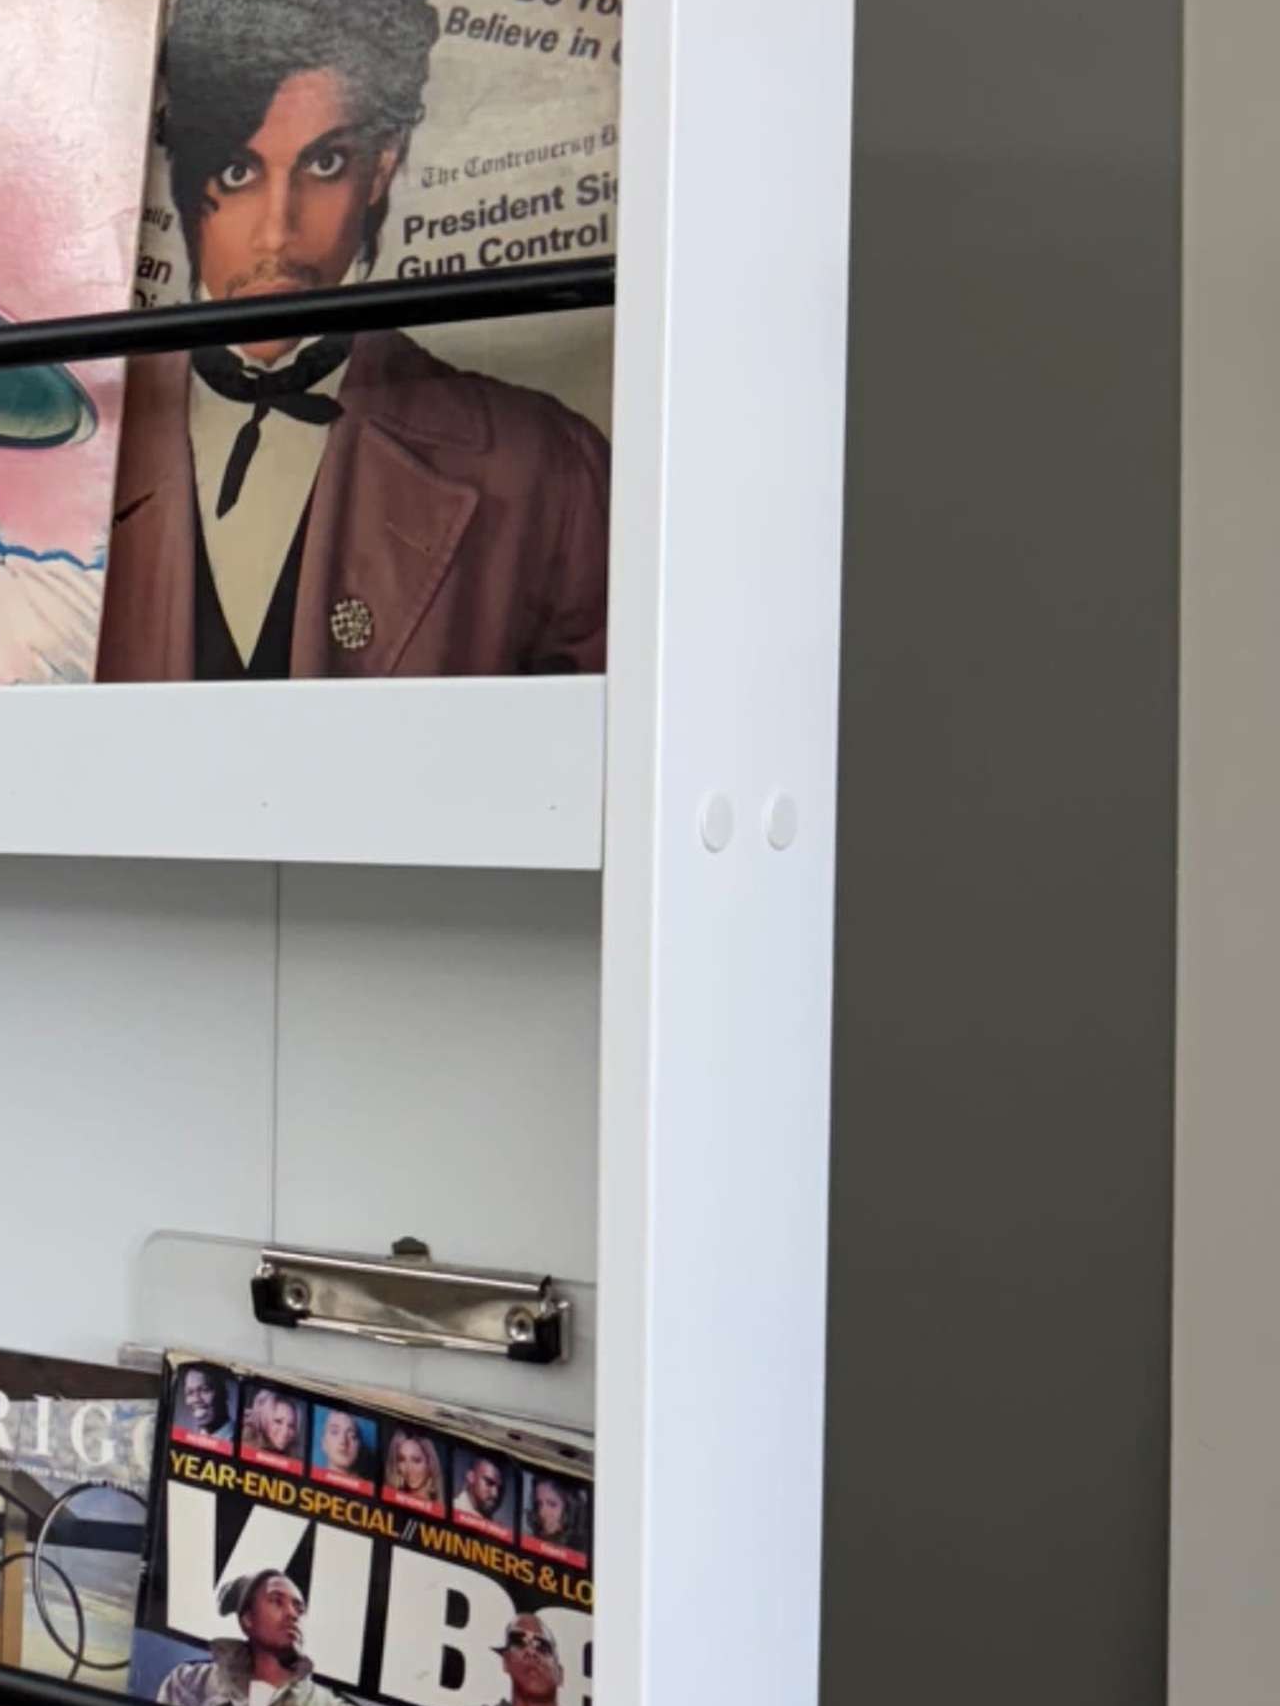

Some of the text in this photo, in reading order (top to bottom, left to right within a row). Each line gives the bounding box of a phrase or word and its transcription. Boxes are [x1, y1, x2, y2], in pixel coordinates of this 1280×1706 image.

[445, 6, 559, 52] Believe
[569, 27, 601, 58] in
[421, 165, 459, 188] The
[464, 133, 595, 179] Controversy
[403, 185, 565, 245] President
[397, 213, 608, 279] Gun Control
[169, 1449, 297, 1506] YEAR-END
[299, 1487, 400, 1538] SPECIAL
[421, 1524, 536, 1585] WINNERS
[538, 1567, 559, 1593] &
